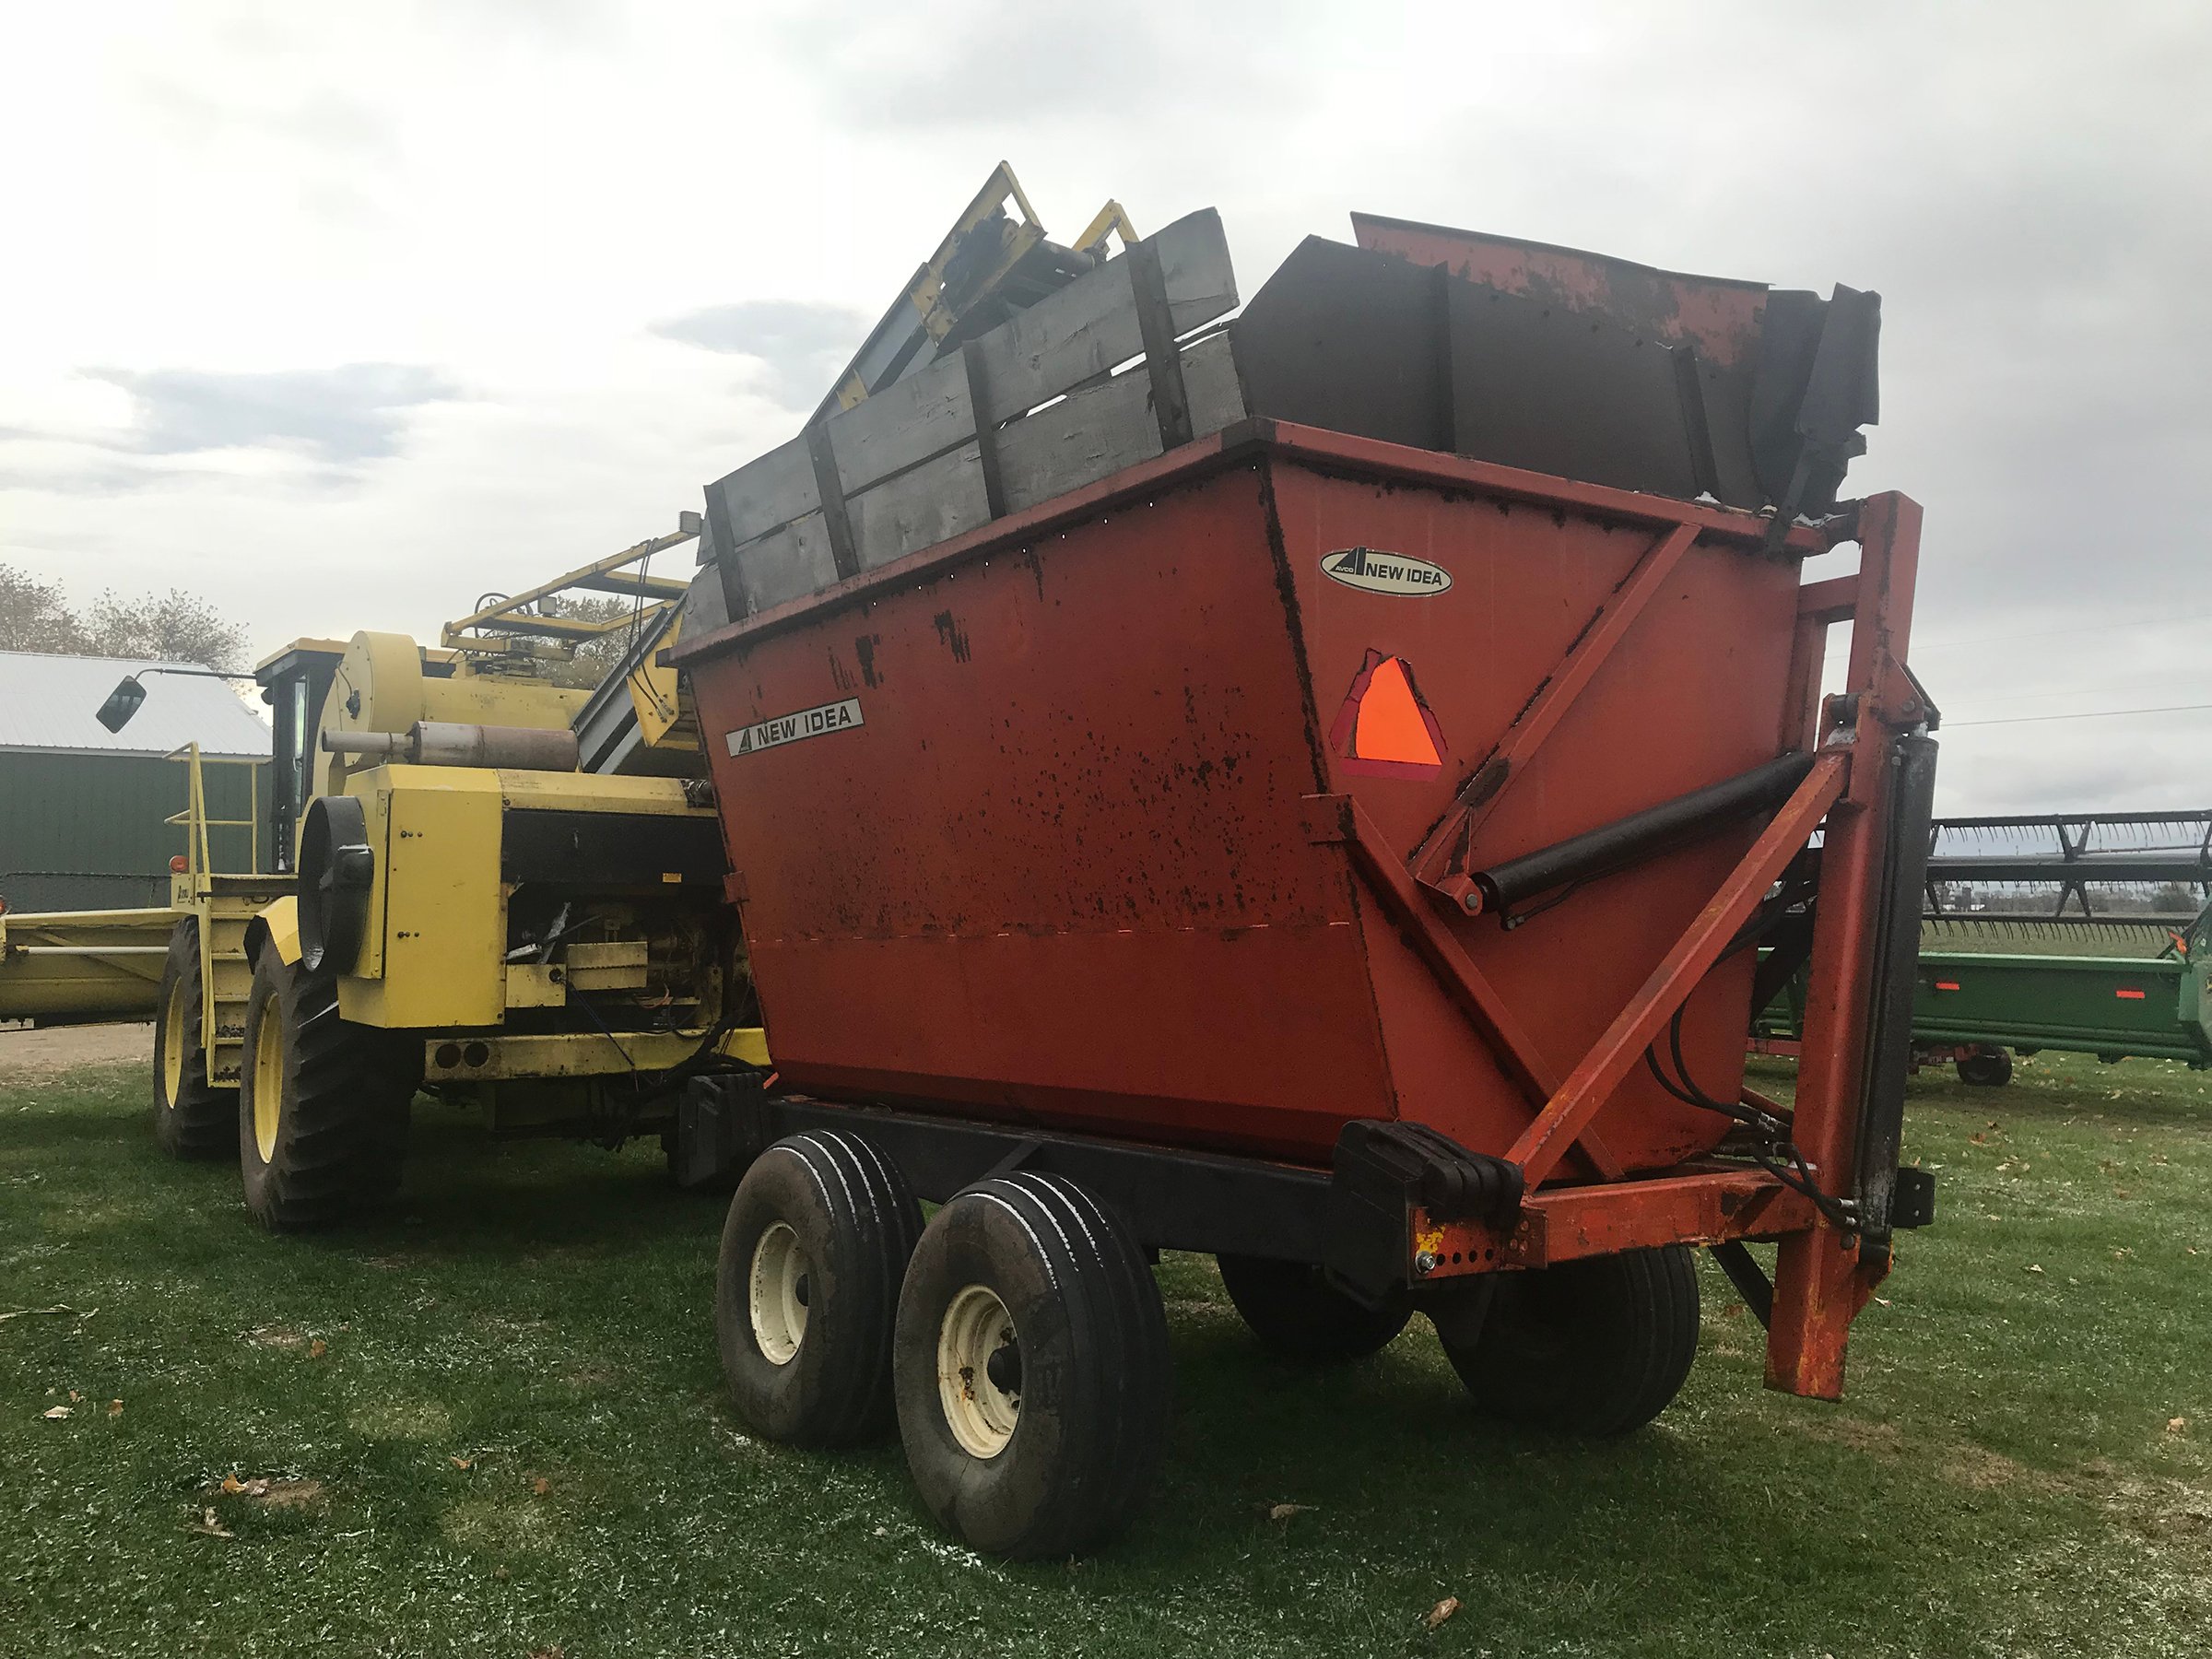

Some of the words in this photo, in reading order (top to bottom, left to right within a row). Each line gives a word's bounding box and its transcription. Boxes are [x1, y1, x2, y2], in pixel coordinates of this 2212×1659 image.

[1365, 562, 1405, 581] NEW
[1406, 568, 1442, 586] IDEA
[757, 718, 796, 746] NEW
[805, 705, 852, 734] IDEA
